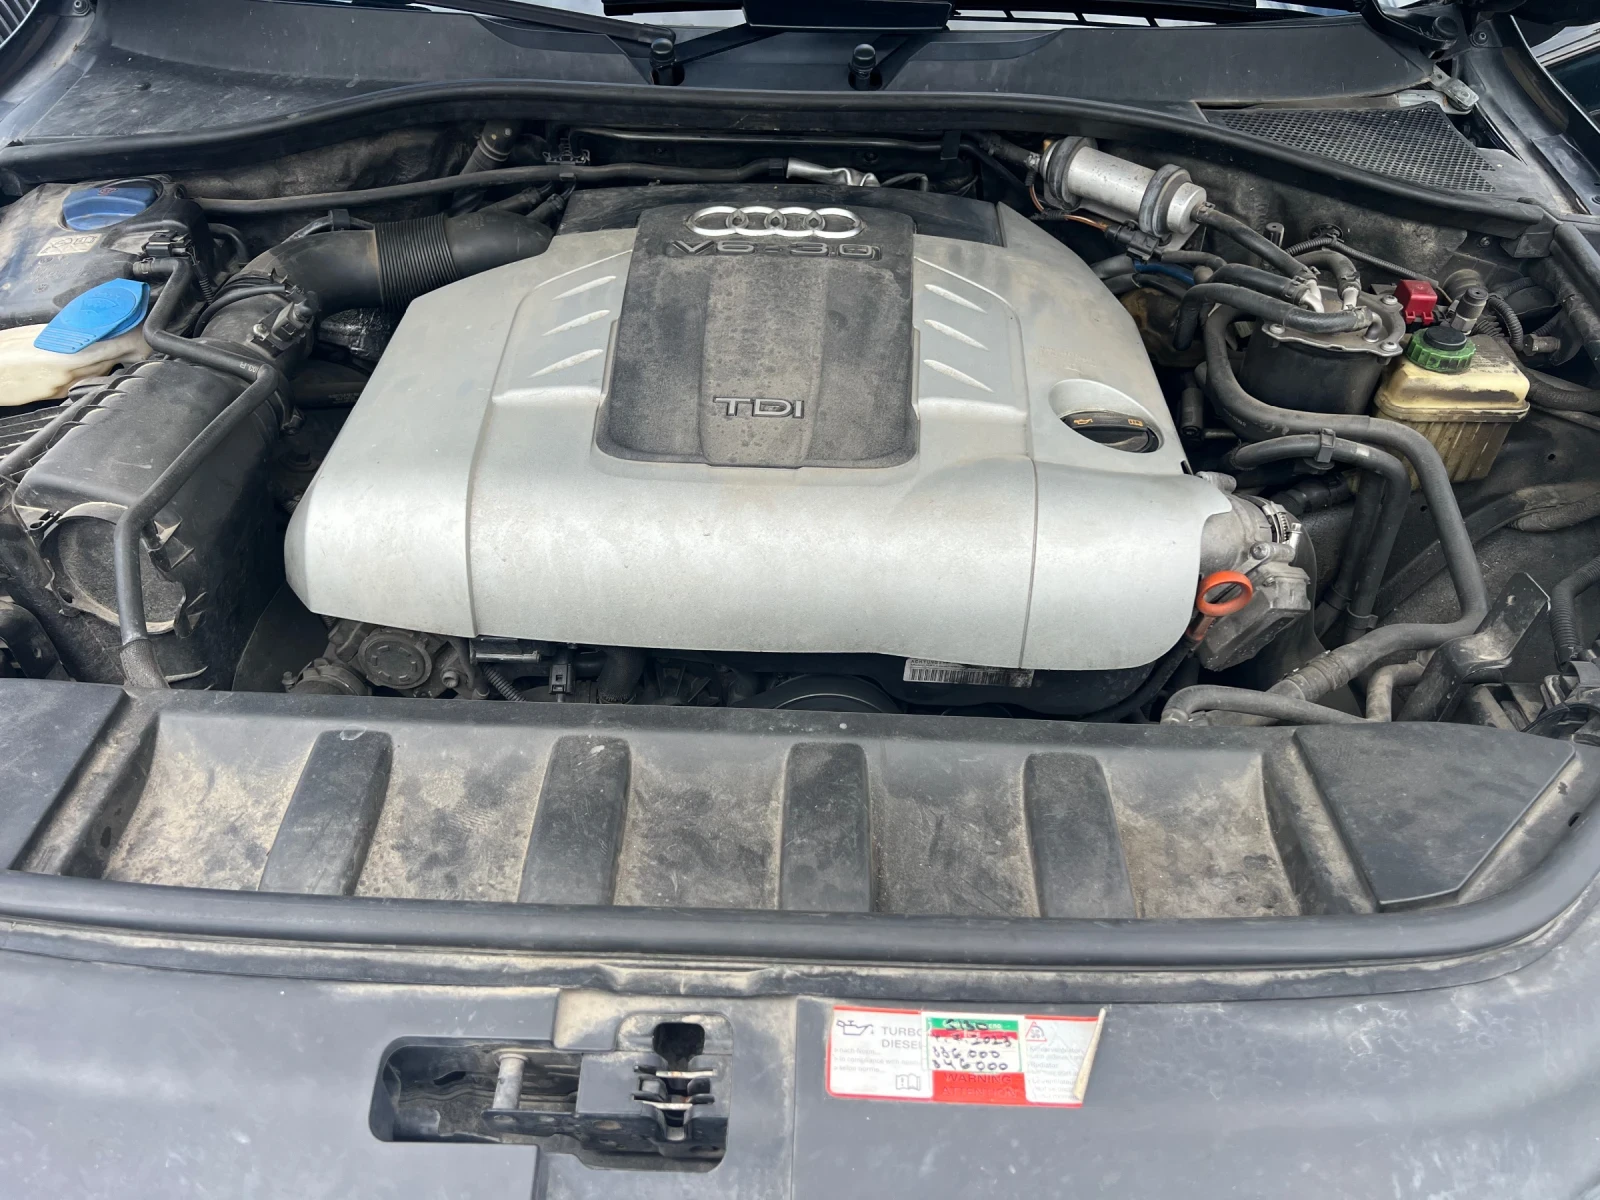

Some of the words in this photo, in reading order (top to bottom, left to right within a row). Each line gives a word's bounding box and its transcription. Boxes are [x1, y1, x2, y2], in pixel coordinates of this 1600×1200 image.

[713, 396, 805, 419] TDI
[943, 1073, 1012, 1084] WARNING
[942, 1086, 1018, 1098] ATTENTION
